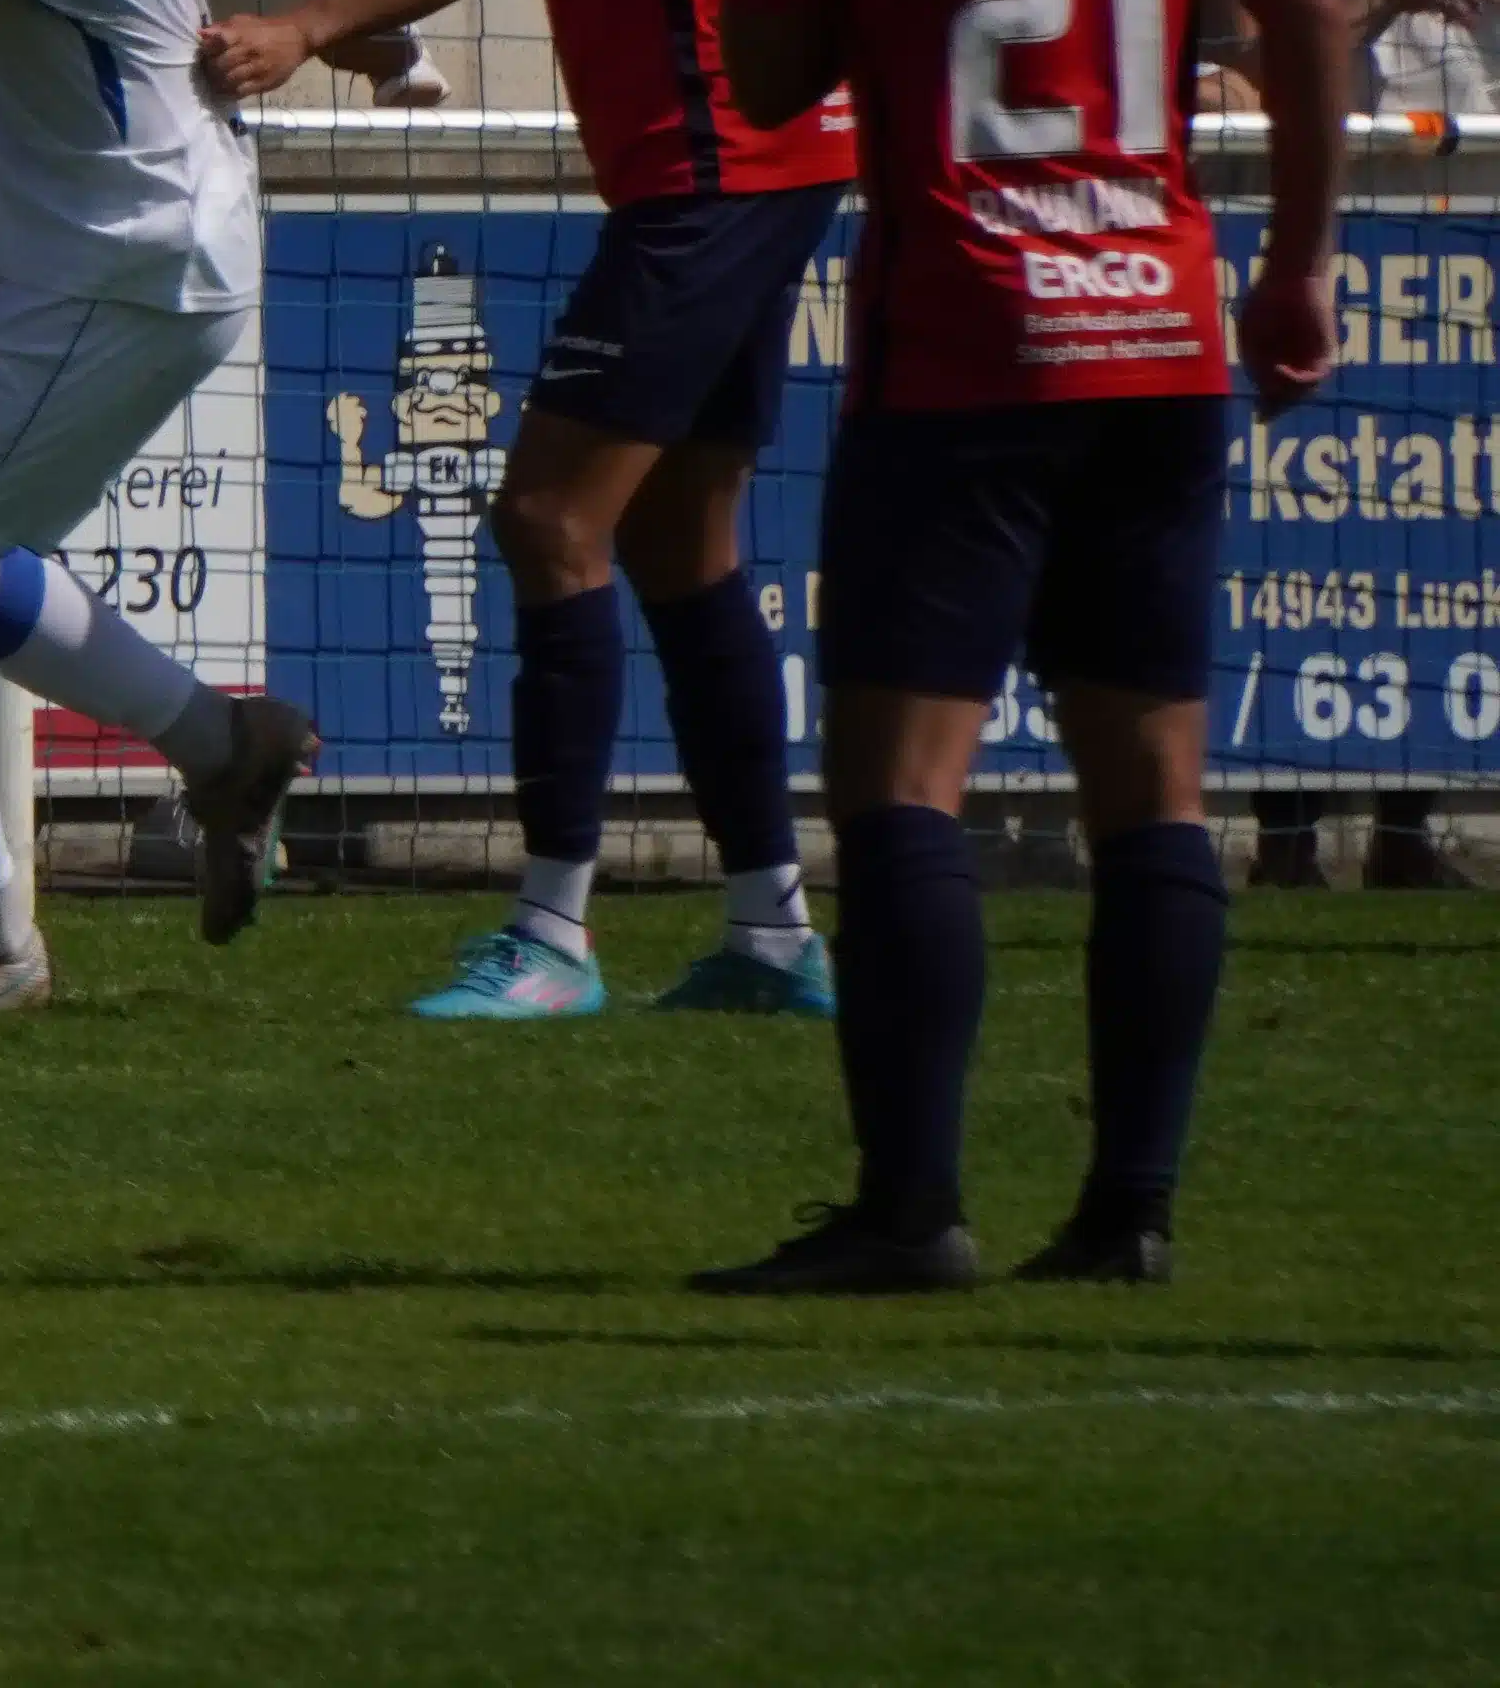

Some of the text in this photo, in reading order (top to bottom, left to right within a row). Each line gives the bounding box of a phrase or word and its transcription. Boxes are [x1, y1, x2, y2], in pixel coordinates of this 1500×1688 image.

[1022, 250, 1175, 299] ERGO
[105, 446, 228, 509] erei
[1226, 569, 1377, 630] 14943
[1293, 651, 1411, 741] 63
